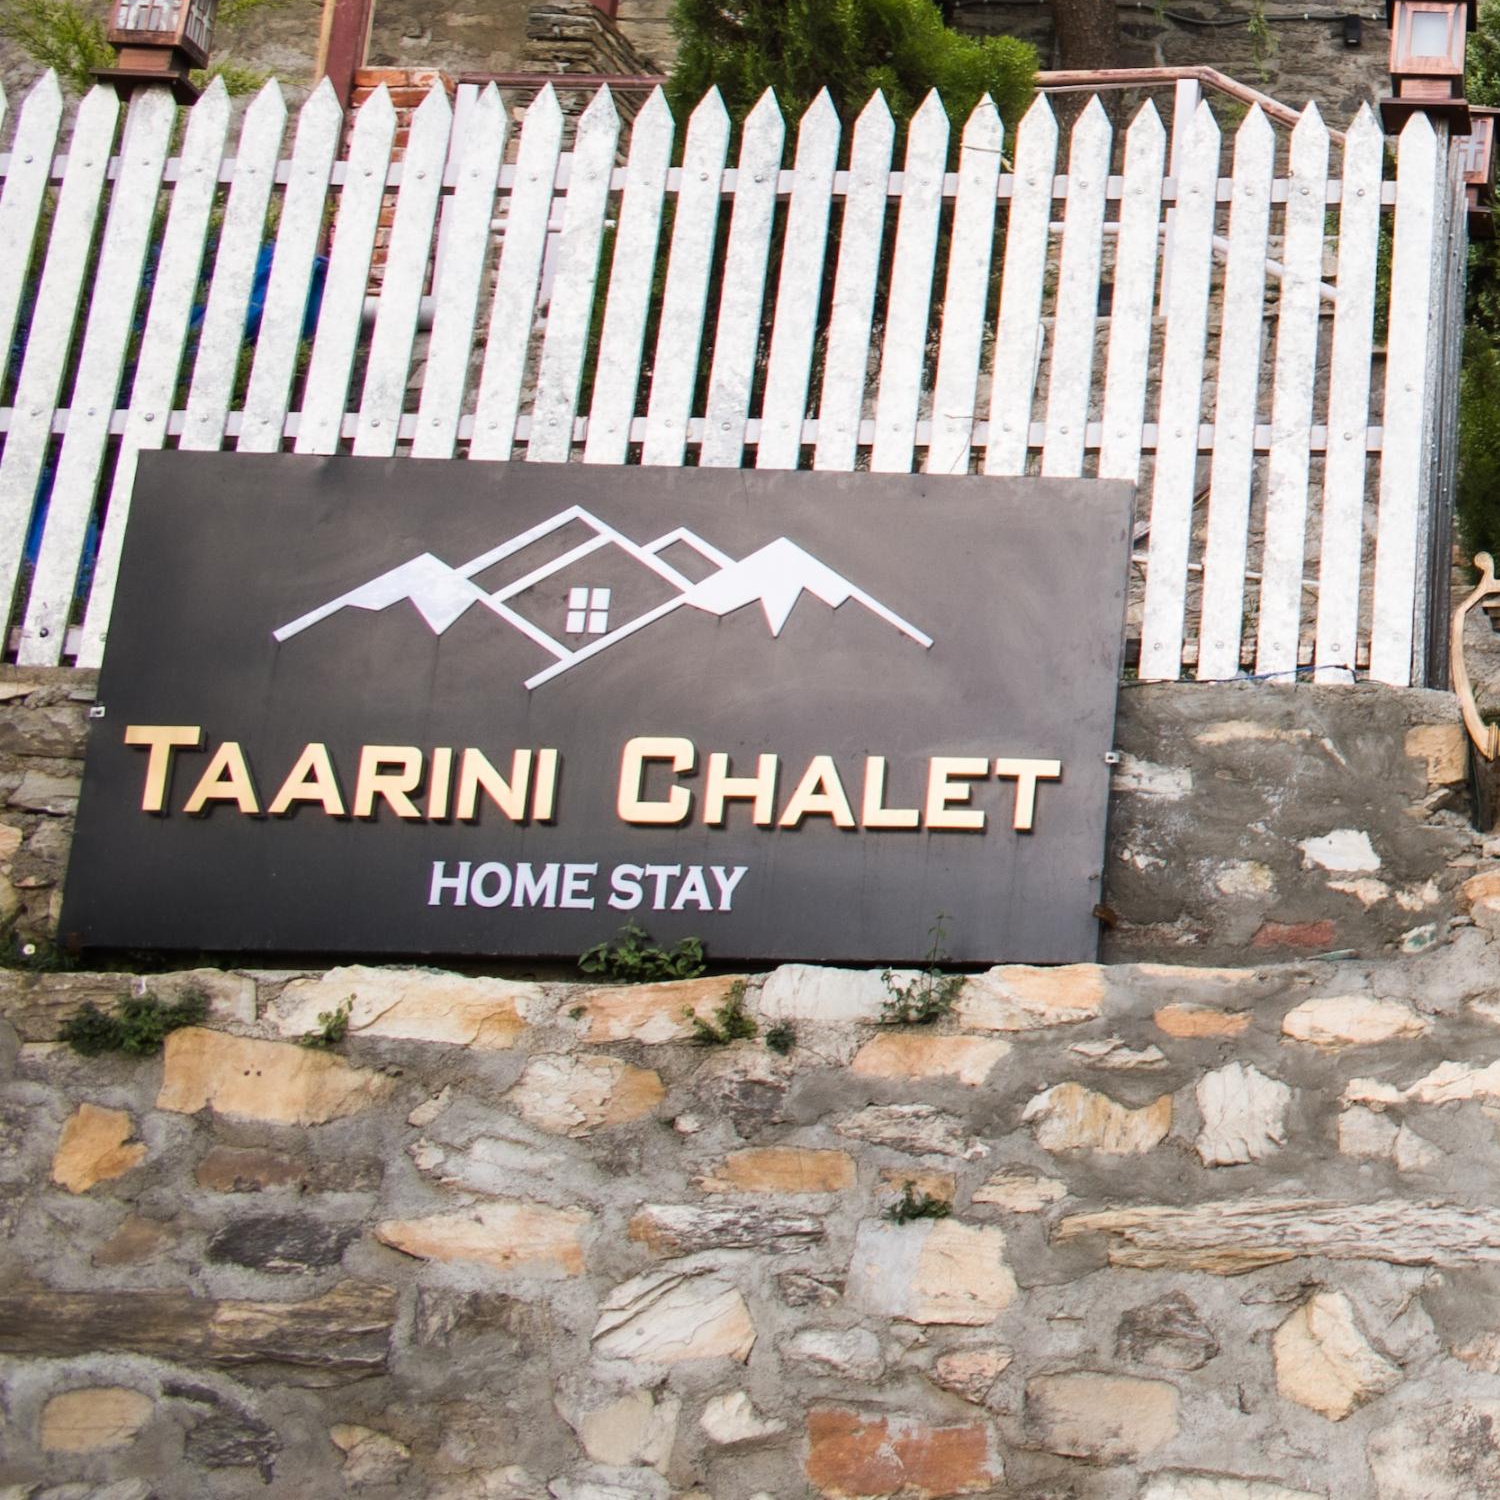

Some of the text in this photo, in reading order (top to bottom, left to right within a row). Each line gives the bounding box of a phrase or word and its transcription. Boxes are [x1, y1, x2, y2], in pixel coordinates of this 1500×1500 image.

[124, 725, 1062, 830] TAARINI CHALET
[427, 860, 749, 912] HOME STAY
